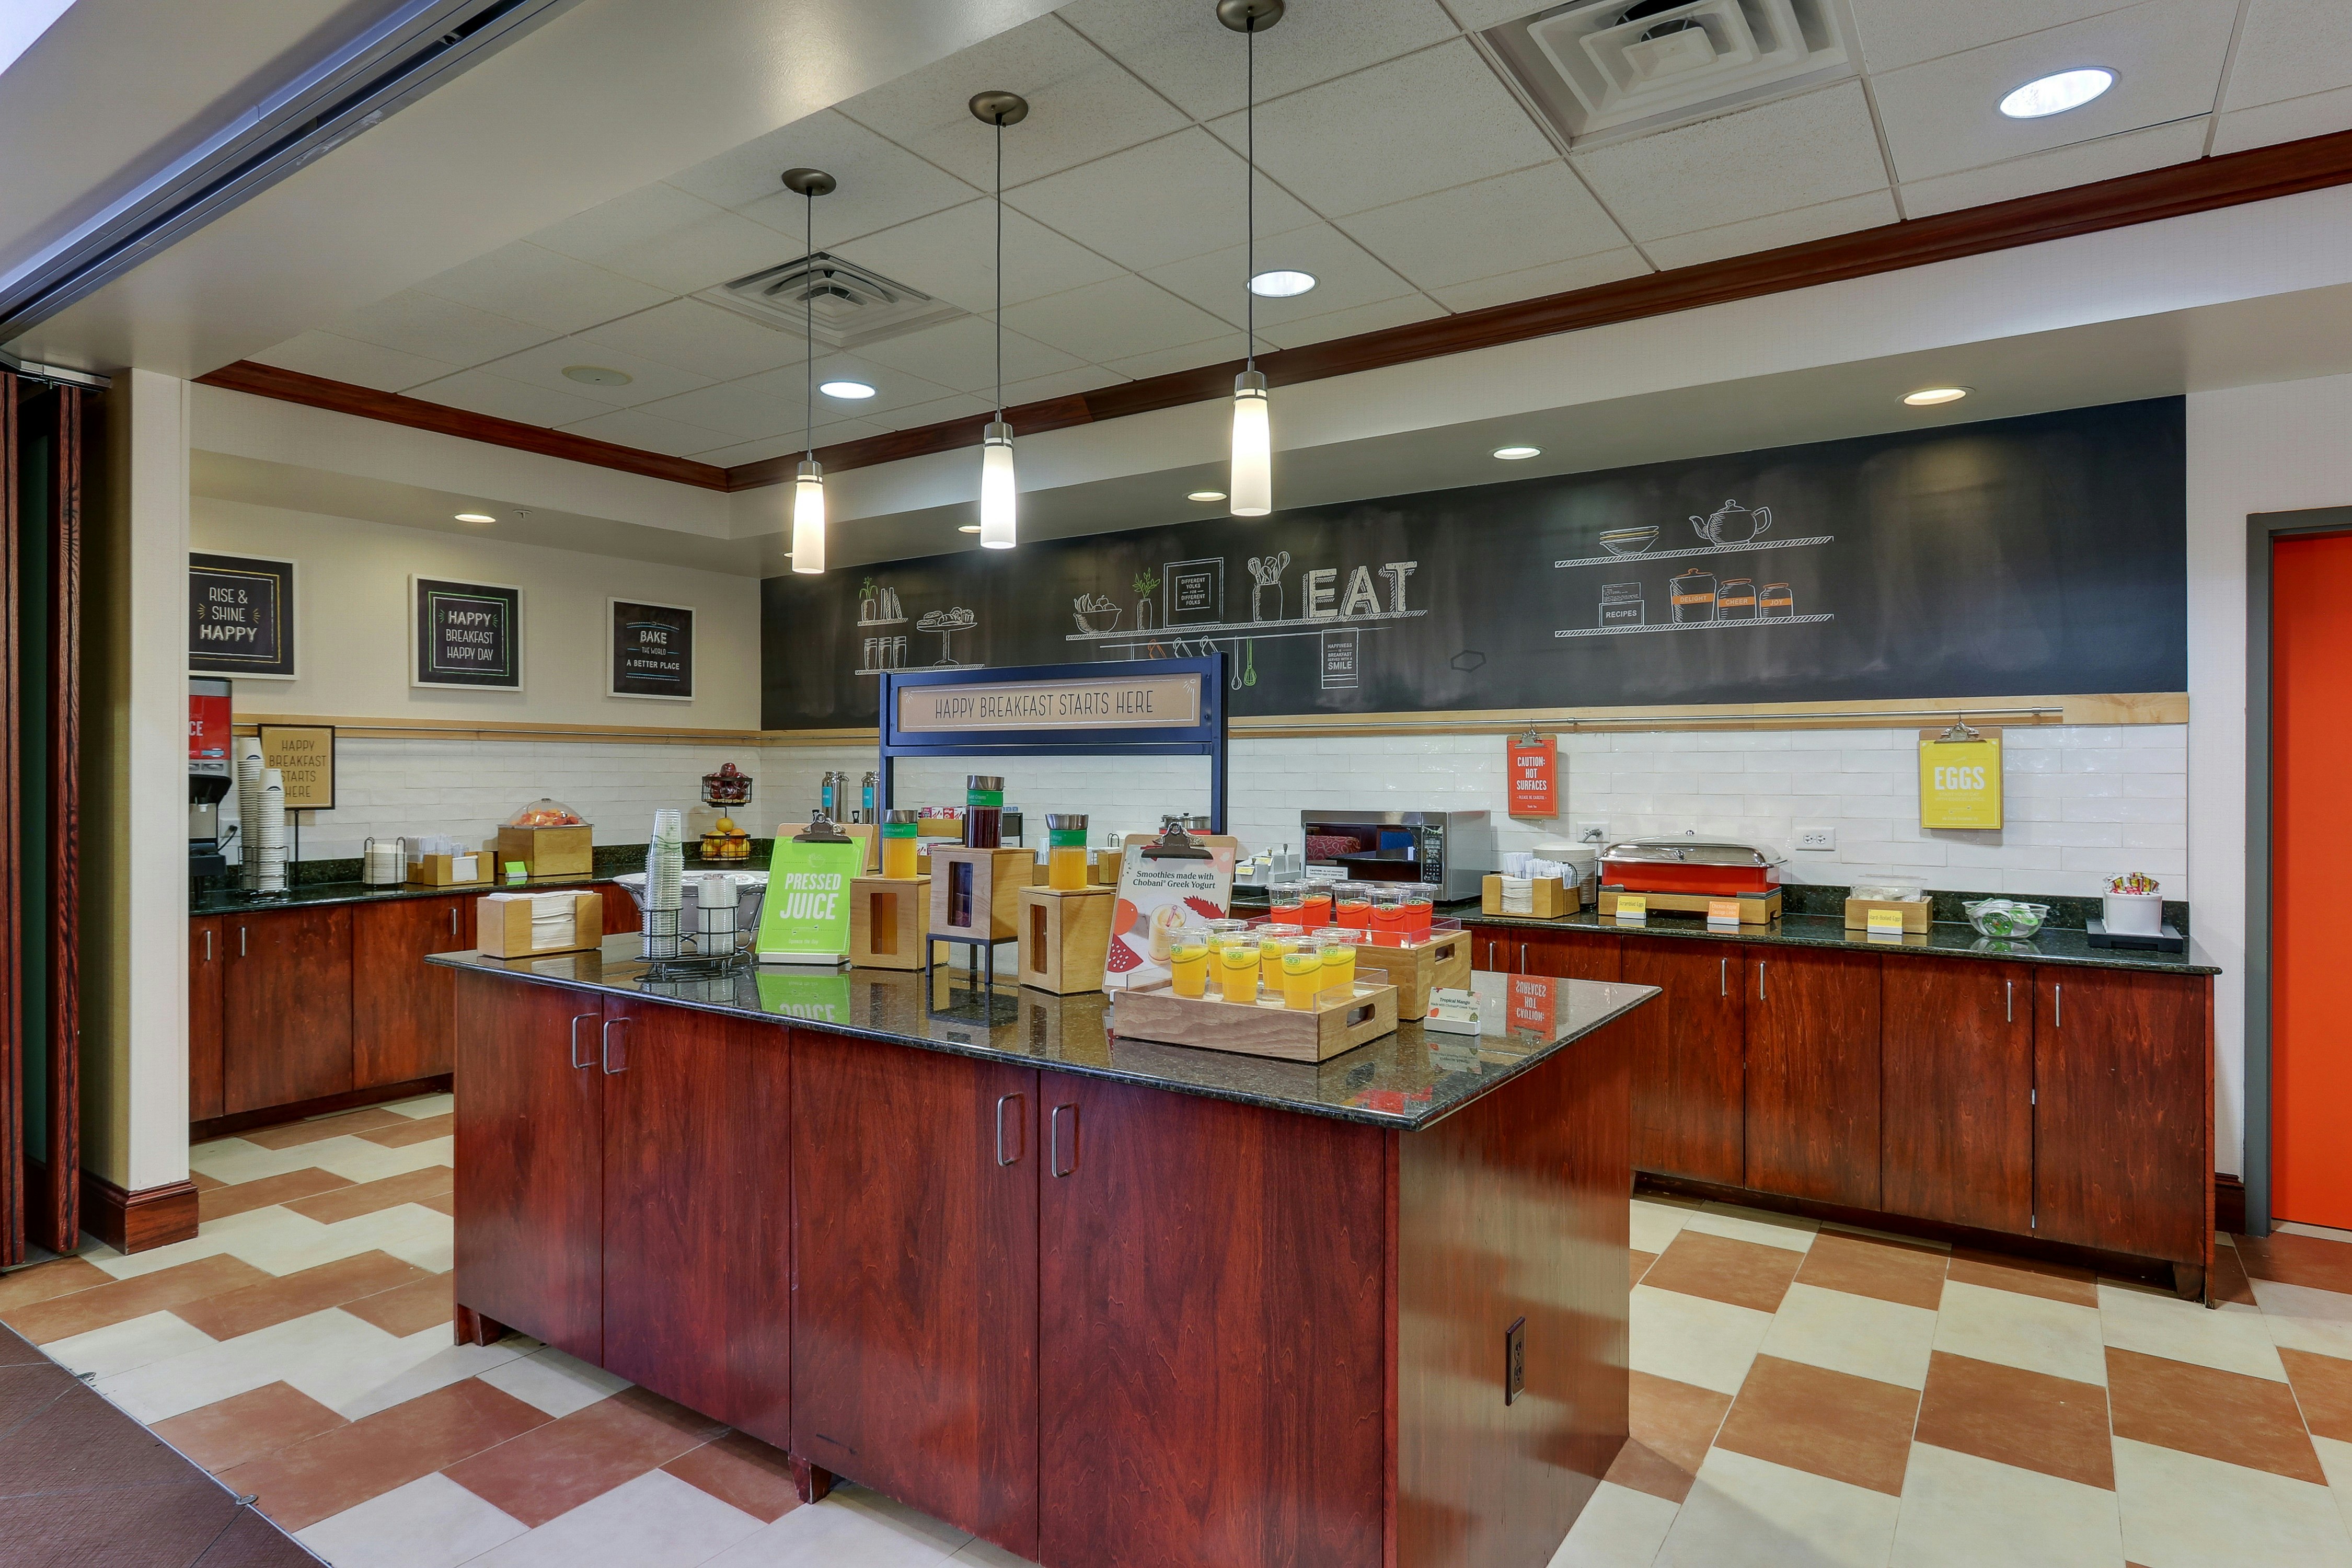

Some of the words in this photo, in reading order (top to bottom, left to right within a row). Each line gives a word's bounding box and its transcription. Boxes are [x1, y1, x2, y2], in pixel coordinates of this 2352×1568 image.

[209, 587, 235, 603] RISE
[238, 590, 248, 604] &
[1304, 561, 1417, 618] EAT
[212, 606, 246, 622] SHINE
[448, 610, 491, 627] HAPPY
[1606, 610, 1637, 618] RECIPES
[200, 624, 257, 642] HAPPY
[446, 629, 493, 644] BREAKFAST
[640, 630, 667, 645] BAKE
[447, 646, 475, 660] HAPPY
[478, 648, 493, 661] DAY
[634, 660, 658, 668] BETTER
[1328, 661, 1352, 670] SMILE
[935, 698, 974, 719] HAPPY
[981, 694, 1054, 718] BREAKFAST
[1059, 692, 1109, 716] STARTS
[1116, 690, 1154, 714] HERE
[282, 740, 315, 751] HAPPY
[269, 755, 326, 767] BREAKFAST
[1517, 756, 1546, 767] CAUTION:
[281, 770, 316, 782] STARTS
[1525, 768, 1537, 778] HOT
[1934, 766, 1985, 790] EGGS
[285, 786, 311, 798] HERE
[1517, 780, 1547, 790] SURFACES
[785, 873, 841, 890] PRESSED
[1168, 880, 1189, 888] Greek
[1191, 881, 1216, 890] Yogurt
[779, 893, 839, 920] JUICE
